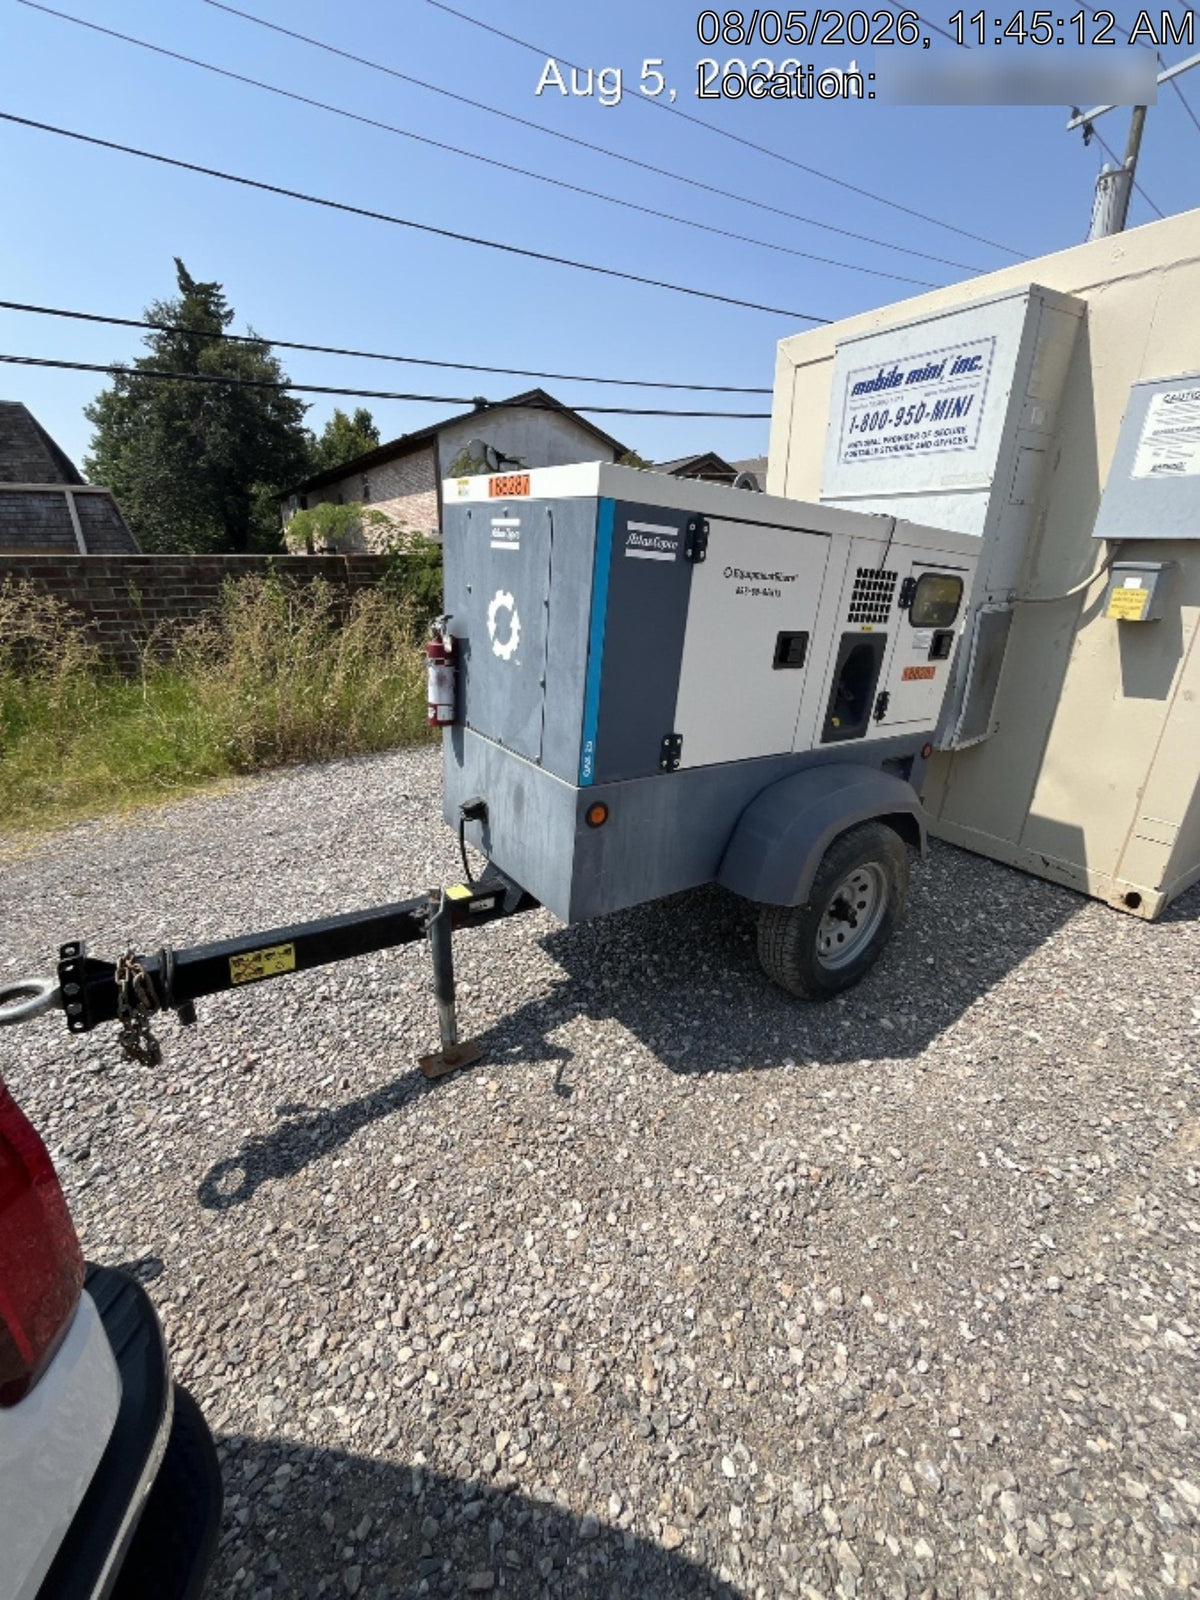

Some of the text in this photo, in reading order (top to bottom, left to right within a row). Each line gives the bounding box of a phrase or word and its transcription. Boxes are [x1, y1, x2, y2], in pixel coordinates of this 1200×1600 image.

[851, 365, 904, 397] mobile
[949, 355, 984, 376] inc.
[849, 394, 975, 434] 1-800-950-MINI
